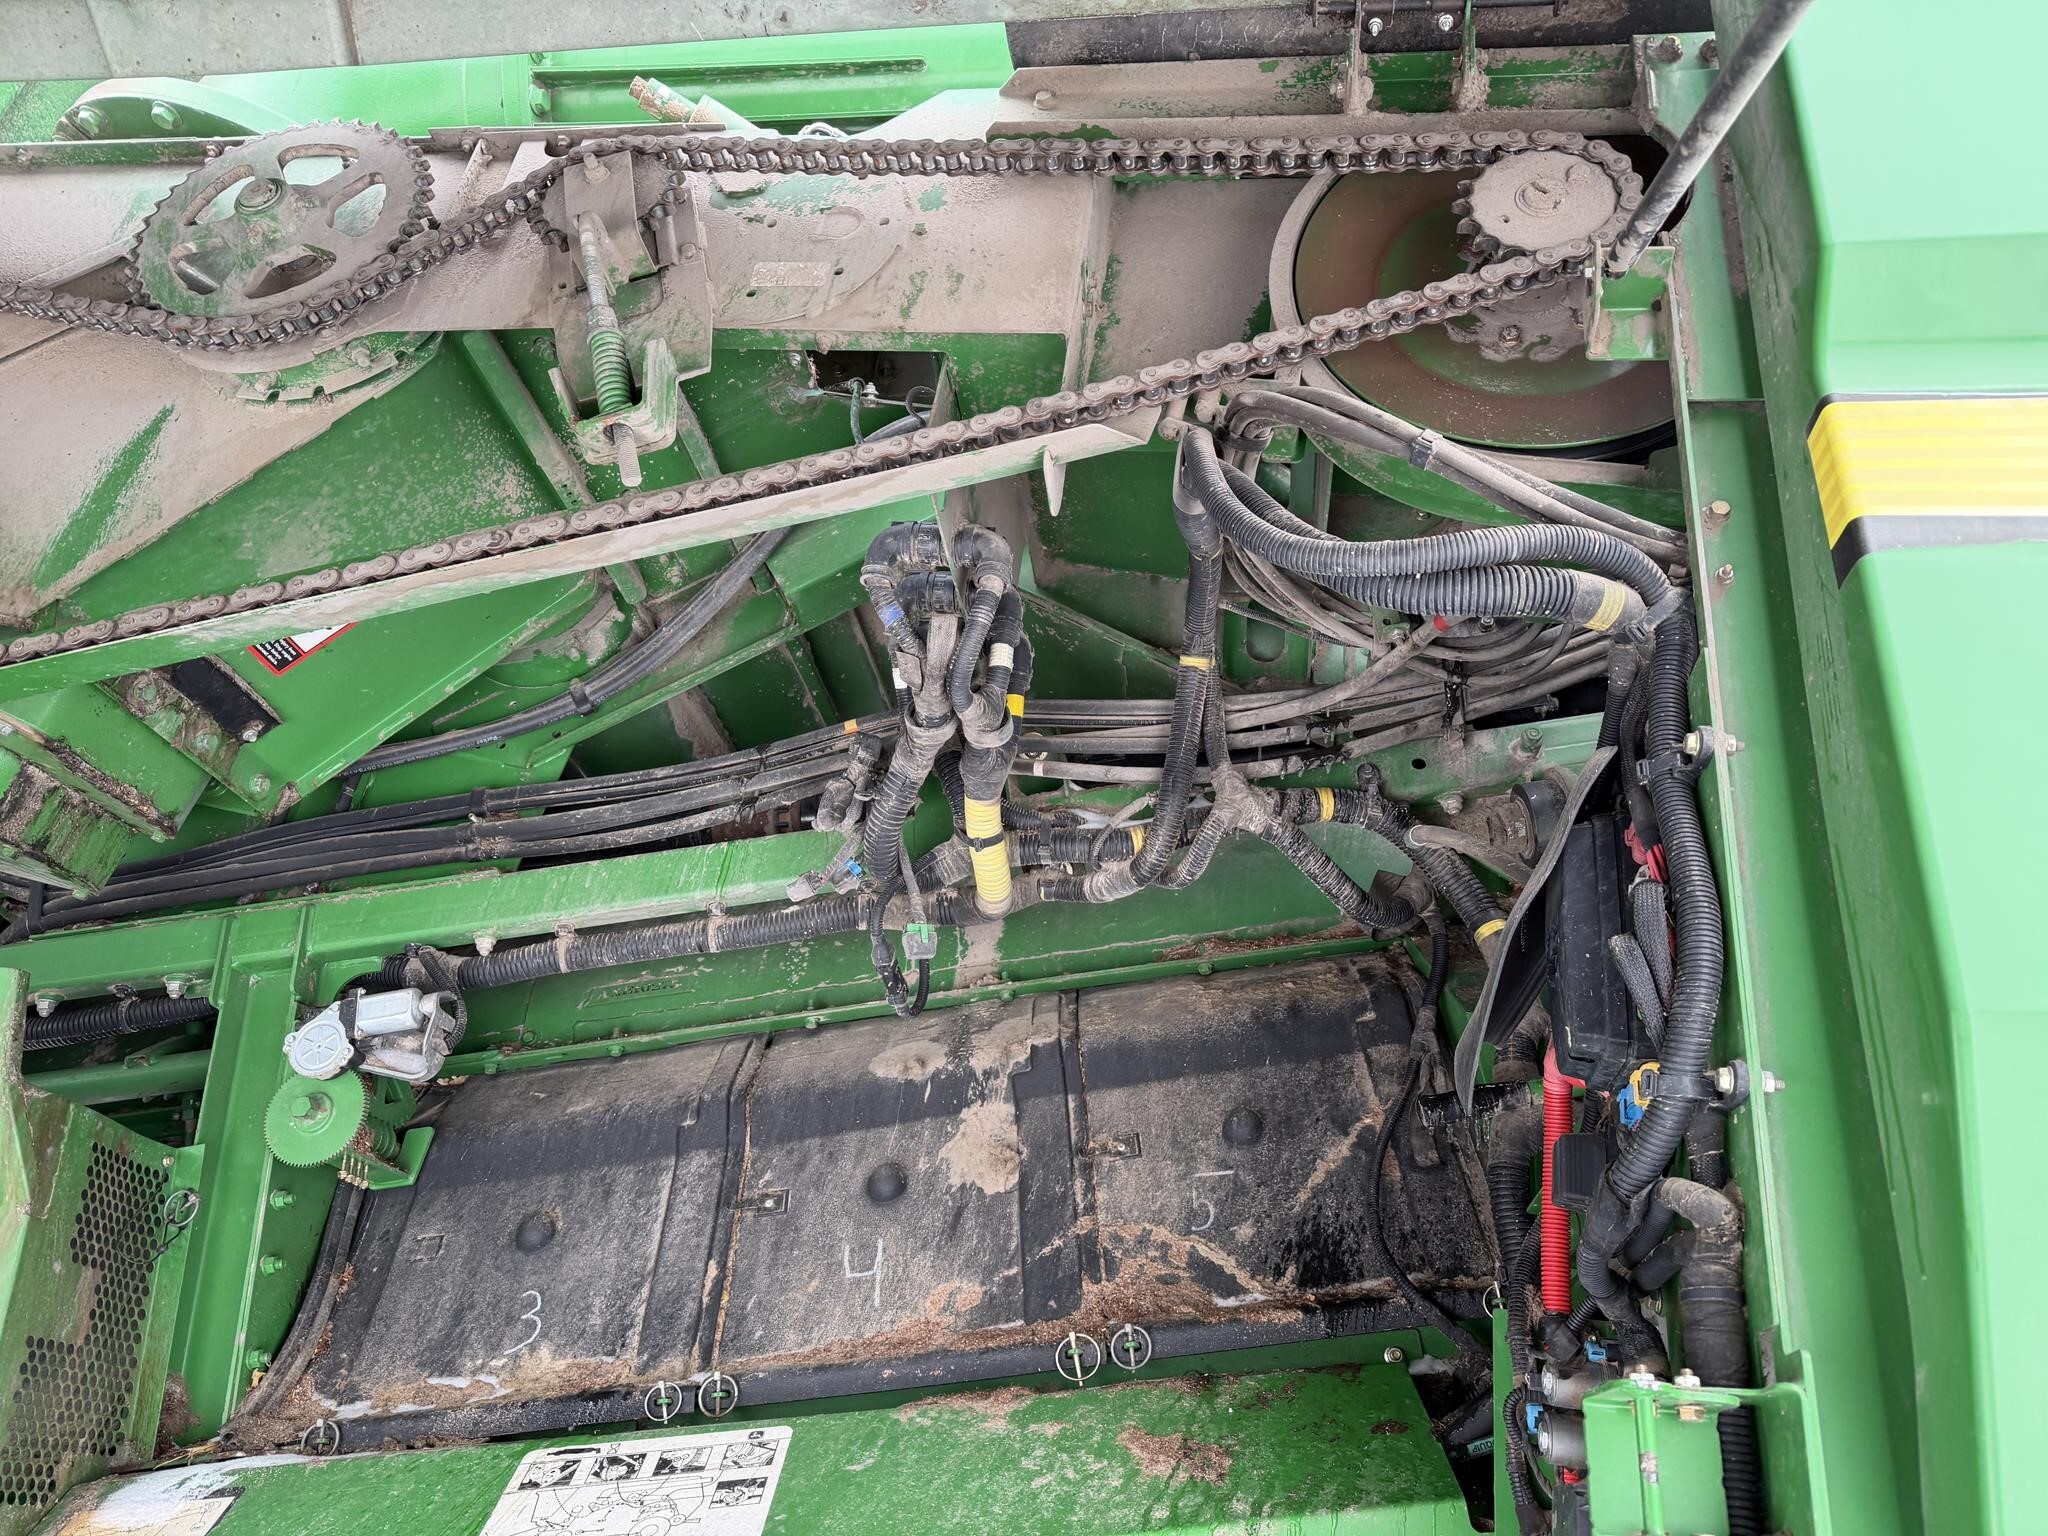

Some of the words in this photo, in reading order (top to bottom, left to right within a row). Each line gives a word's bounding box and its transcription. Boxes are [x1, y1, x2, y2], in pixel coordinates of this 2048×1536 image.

[1190, 1169, 1235, 1231] 5
[842, 1237, 883, 1308] 4
[503, 1290, 542, 1355] 3
